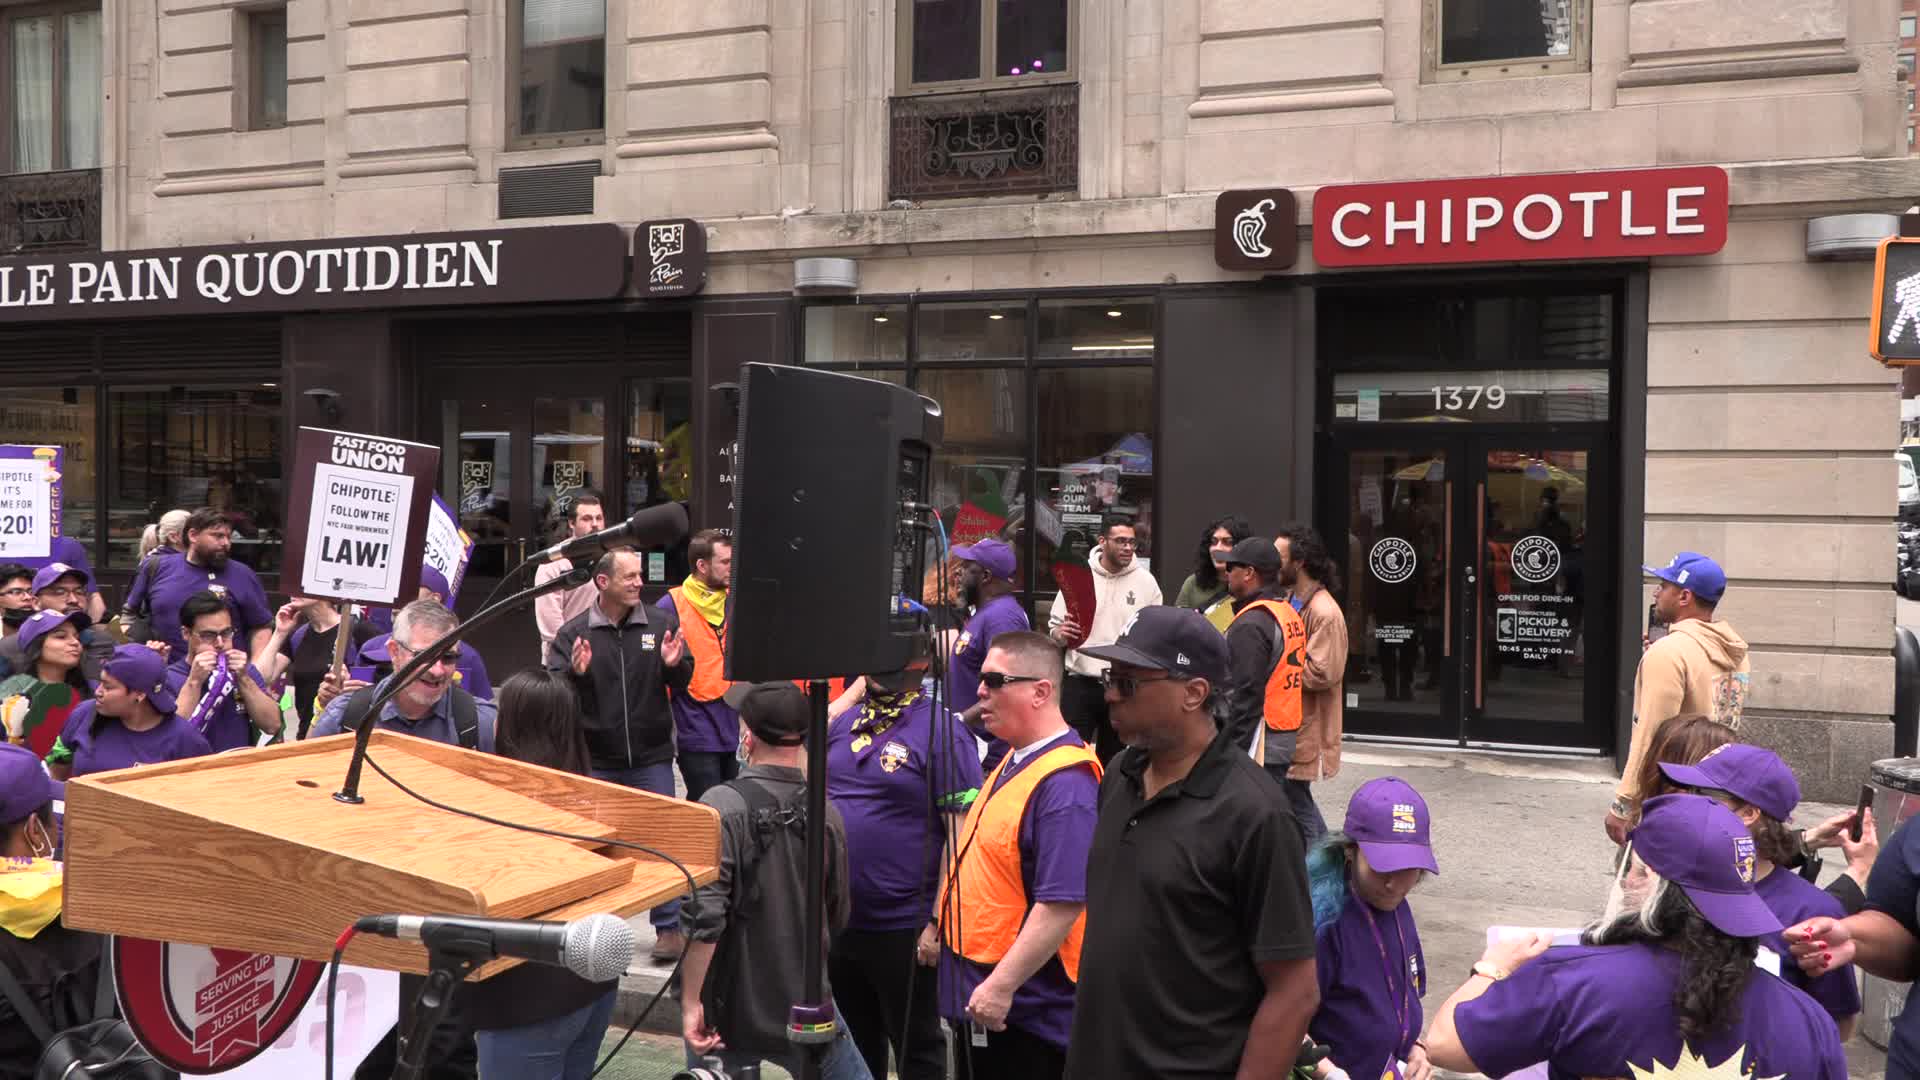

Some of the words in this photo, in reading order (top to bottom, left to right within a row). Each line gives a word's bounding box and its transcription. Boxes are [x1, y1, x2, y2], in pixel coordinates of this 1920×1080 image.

[1331, 186, 1705, 248] CHIPOTLE
[0, 264, 55, 307] LE
[69, 257, 182, 304] PAIN
[196, 239, 504, 303] QUOTIDIEN
[1431, 385, 1506, 410] 1379
[333, 435, 367, 450] FAST
[367, 441, 406, 455] FOOD
[331, 447, 405, 473] UNION
[0, 472, 33, 482] IPOTLE
[4, 487, 21, 495] IT'S
[331, 482, 396, 503] CHIPOTLE:
[1063, 484, 1087, 493] JOIN
[16, 500, 33, 509] FOR
[1063, 495, 1085, 503] OUR
[330, 504, 371, 520] FOLLOW
[371, 510, 391, 522] THE
[321, 536, 389, 569] LAW!
[1373, 540, 1412, 557] CHIPOTLE
[1515, 538, 1557, 556] CHIPOTLE
[1498, 594, 1520, 602] OPEN
[1523, 594, 1540, 602] FOR
[1542, 595, 1573, 603] DINE-IN
[1518, 617, 1559, 627] PICKUP
[1561, 619, 1568, 627] &
[1518, 627, 1572, 637] DELIVERY
[1539, 646, 1562, 654] 10:00
[200, 965, 252, 1005] SERVING
[255, 954, 271, 972] UP
[211, 994, 260, 1034] JUSTICE
